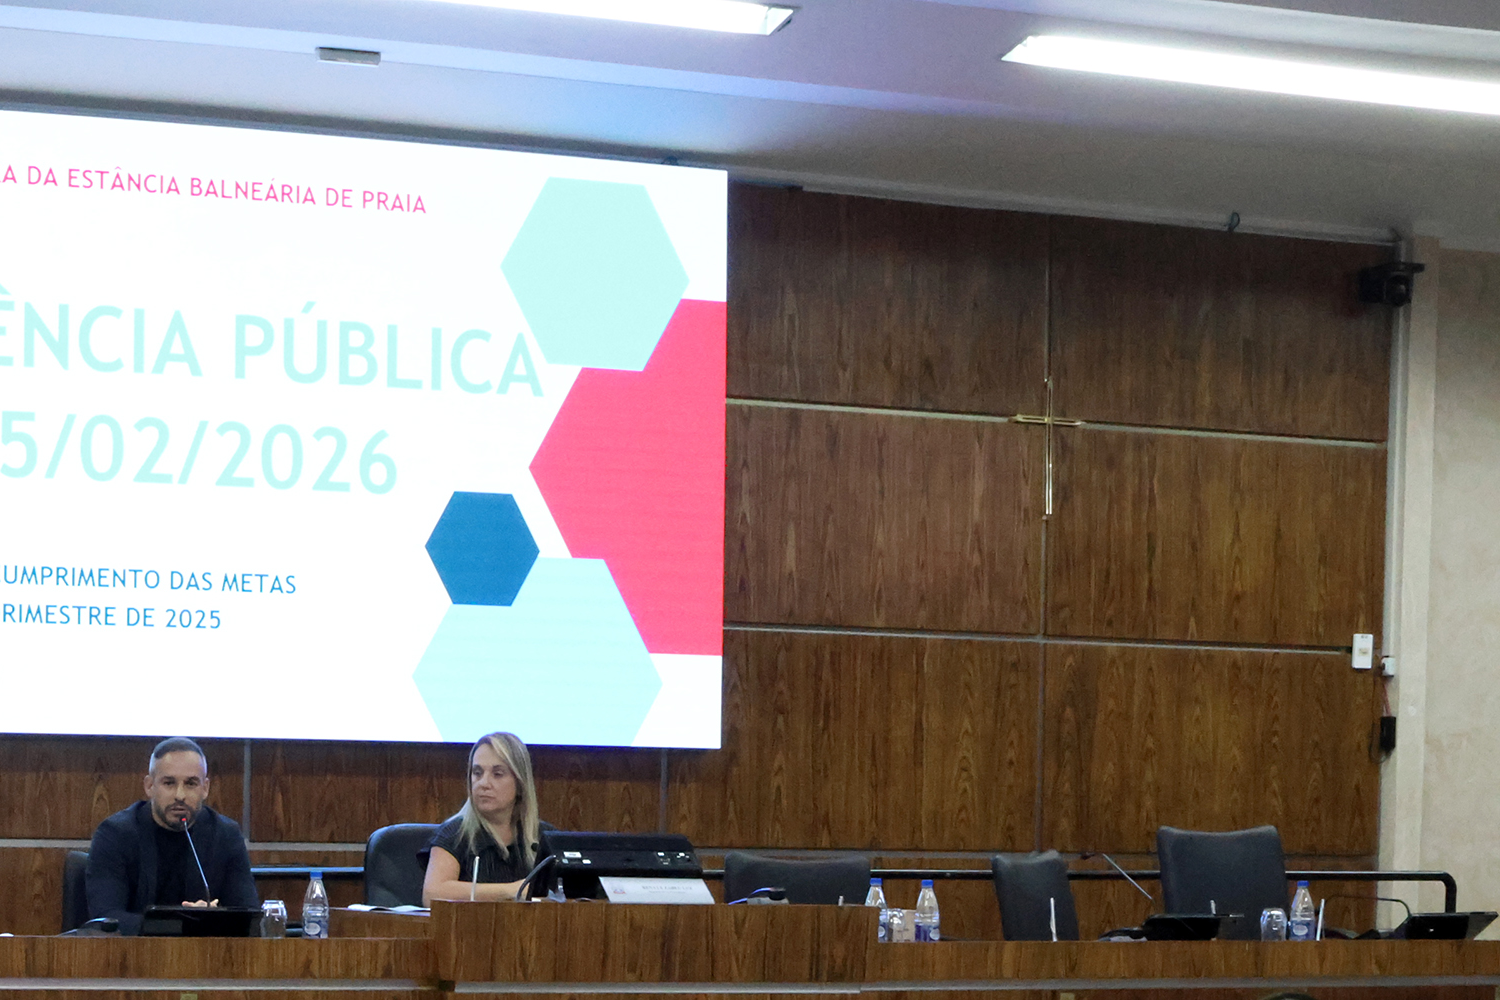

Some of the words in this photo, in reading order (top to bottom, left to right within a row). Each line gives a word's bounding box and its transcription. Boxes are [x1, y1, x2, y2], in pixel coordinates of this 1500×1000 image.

[27, 165, 59, 187] DA
[67, 166, 181, 196] ESTÂNCIA
[190, 177, 317, 206] BALNEÁRIA
[325, 187, 354, 209] DE
[362, 189, 427, 214] PRAIA
[235, 301, 544, 398] PÚBLICA
[169, 570, 213, 592] DAS
[221, 572, 297, 595] METAS
[126, 606, 156, 628] DE
[165, 608, 222, 630] 2025
